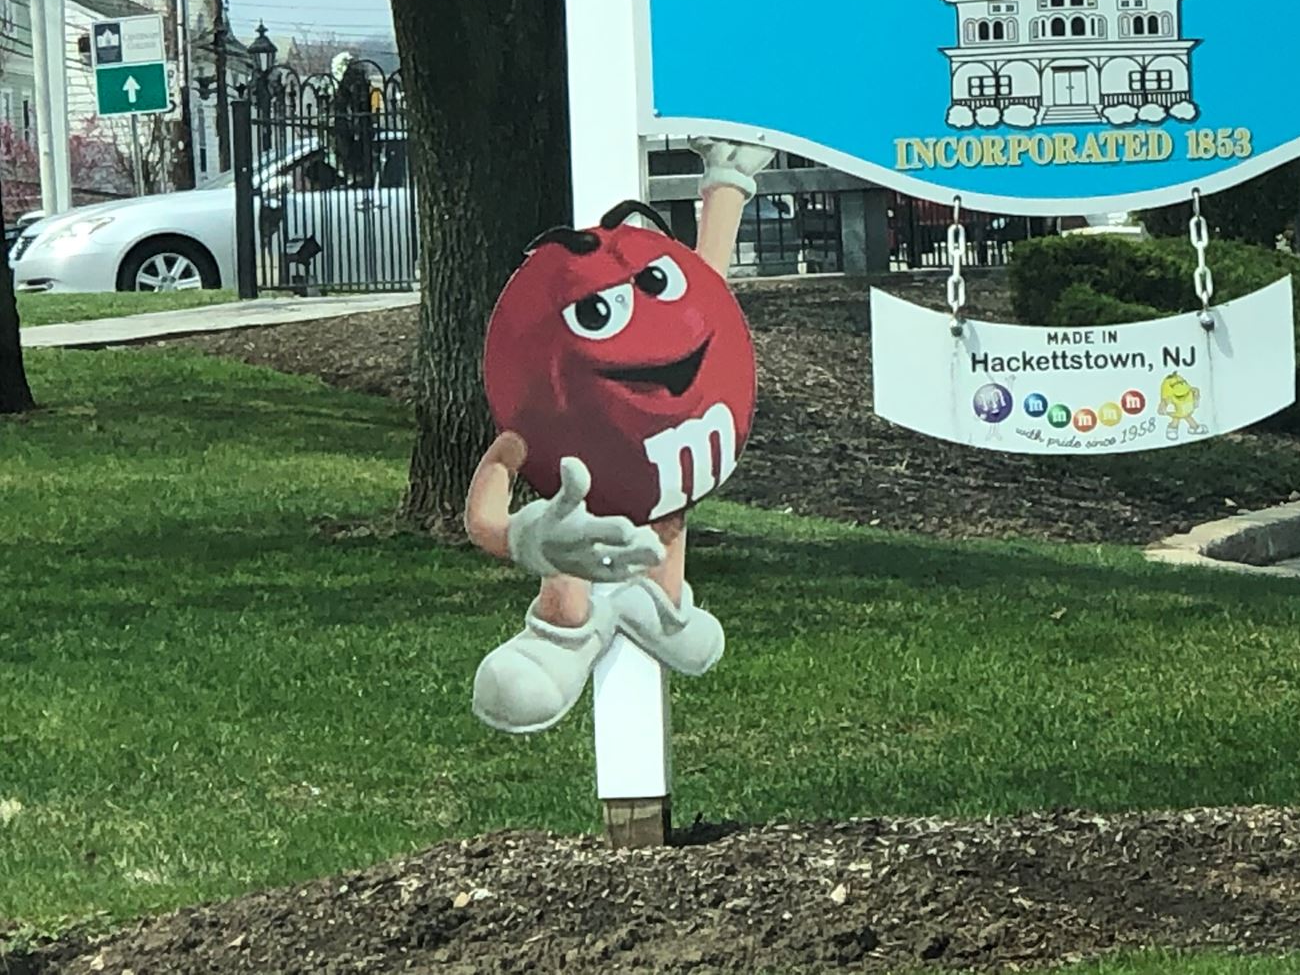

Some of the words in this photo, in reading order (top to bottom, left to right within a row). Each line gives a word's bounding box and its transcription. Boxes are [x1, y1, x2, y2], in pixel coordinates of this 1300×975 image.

[894, 129, 1173, 170] INCORPORATED
[1184, 127, 1252, 160] 1853
[1047, 331, 1094, 345] MADE
[1102, 330, 1118, 344] IN
[971, 350, 1154, 374] Hackettstown,
[1162, 345, 1196, 368] NJ
[1028, 398, 1044, 413] m
[1052, 408, 1068, 424] m
[1077, 413, 1094, 428] m
[1125, 394, 1141, 410] m
[1015, 427, 1045, 443] with
[1046, 432, 1083, 449] pride
[1084, 436, 1117, 449] since
[1120, 416, 1157, 444] 1958
[643, 403, 738, 520] m
